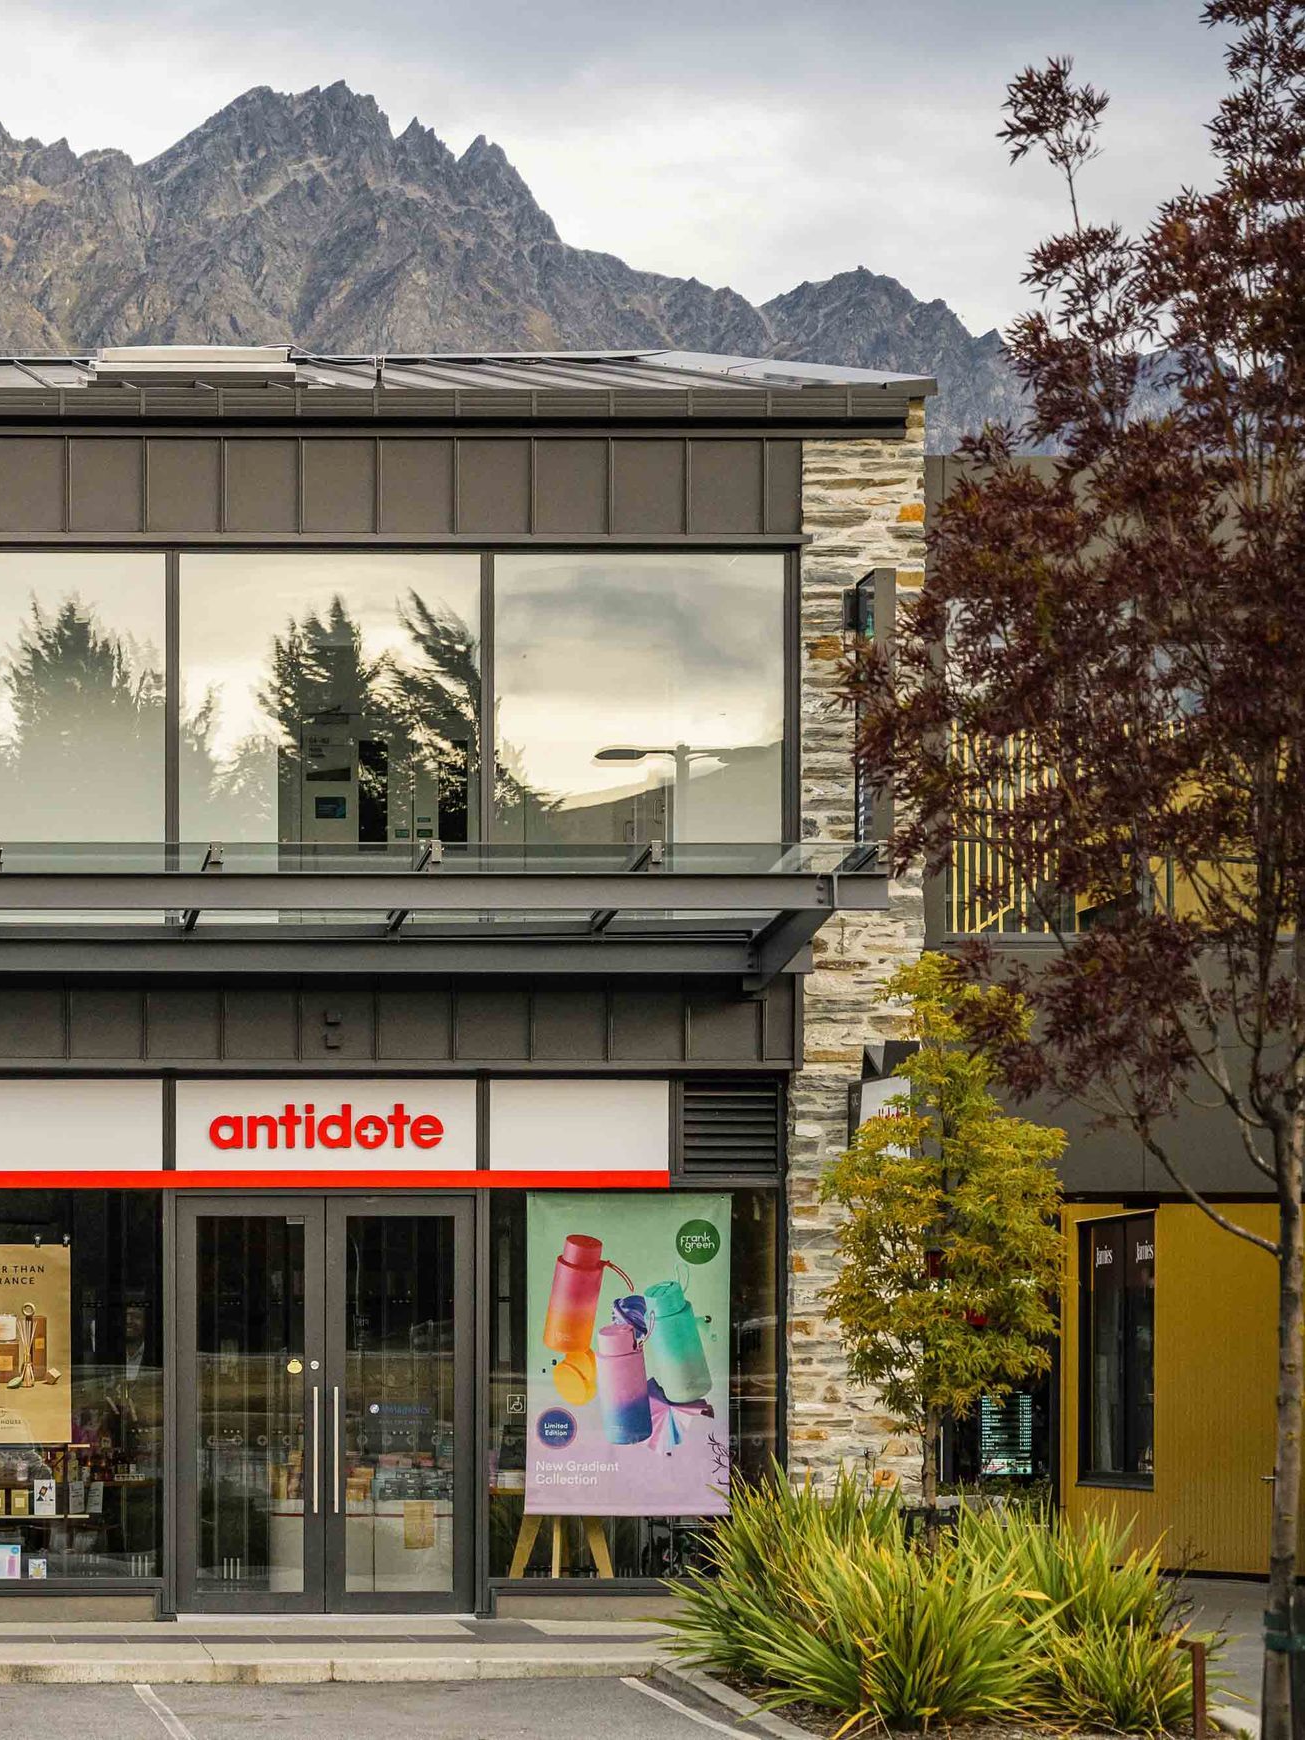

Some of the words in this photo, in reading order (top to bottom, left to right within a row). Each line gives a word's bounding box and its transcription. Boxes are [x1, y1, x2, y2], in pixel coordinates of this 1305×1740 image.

[209, 1103, 444, 1150] antidote
[680, 1231, 711, 1247] frank
[684, 1242, 715, 1253] green
[12, 1265, 45, 1273] THAN
[535, 1460, 564, 1472] New
[567, 1460, 619, 1472] Gradient
[535, 1473, 598, 1485] Collection
